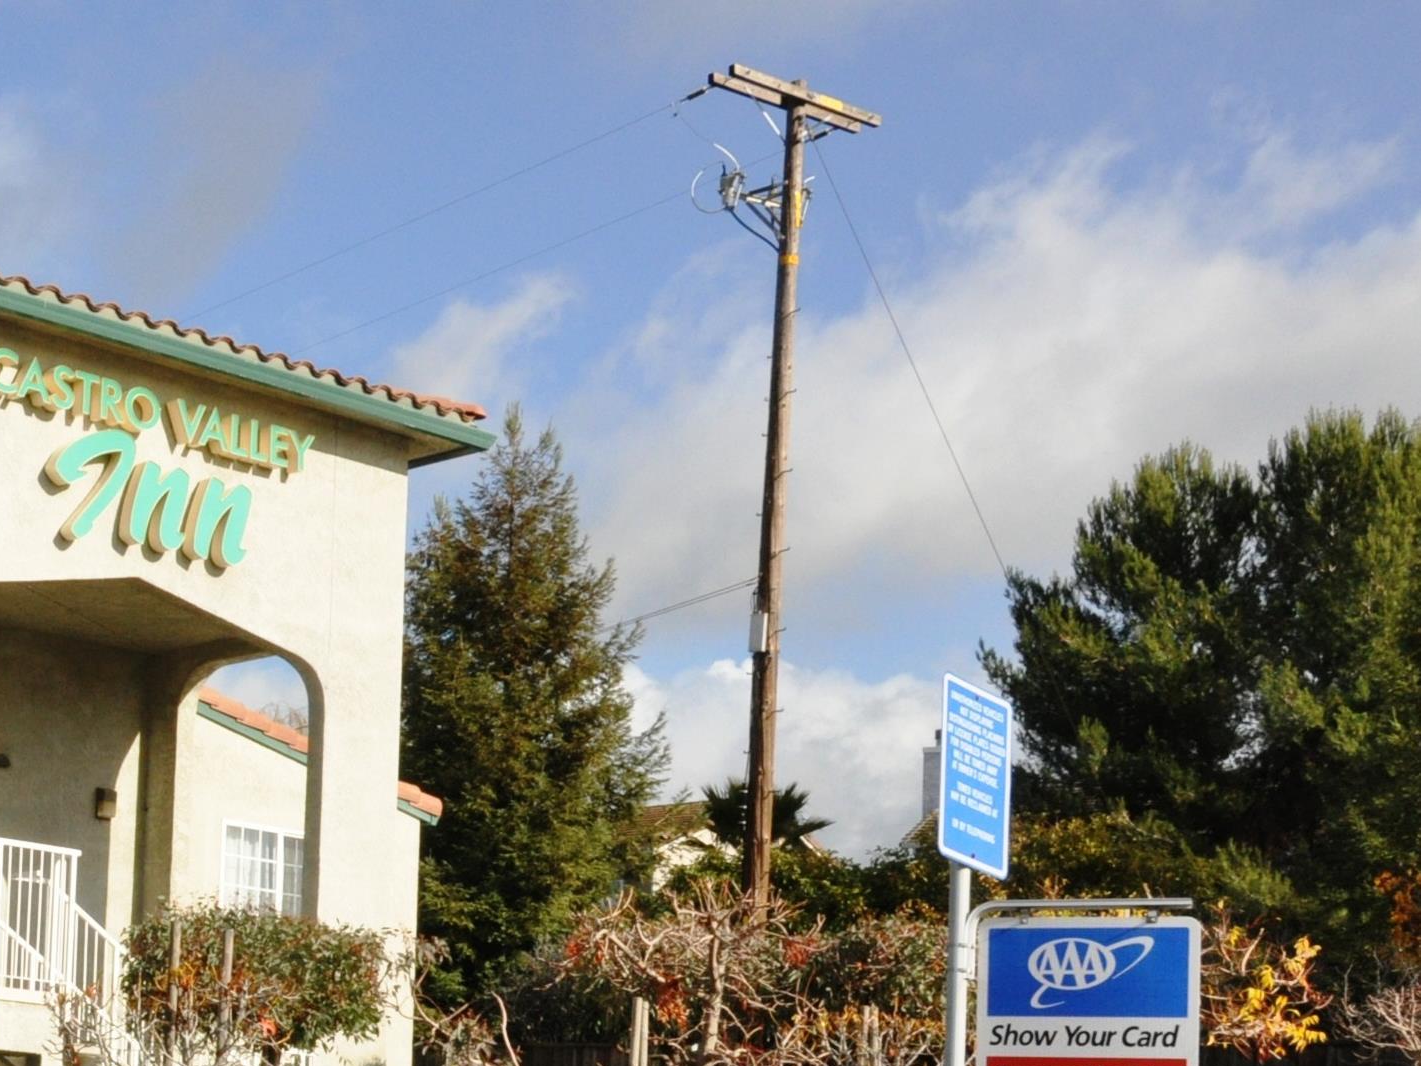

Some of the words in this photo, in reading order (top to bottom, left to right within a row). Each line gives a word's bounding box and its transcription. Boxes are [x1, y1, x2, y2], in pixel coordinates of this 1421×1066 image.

[173, 397, 316, 474] VALLEY
[49, 428, 253, 569] Inn
[1036, 940, 1109, 987] AAA
[989, 1023, 1058, 1047] Show
[1063, 1025, 1117, 1048] Your
[1121, 1025, 1179, 1048] Card
